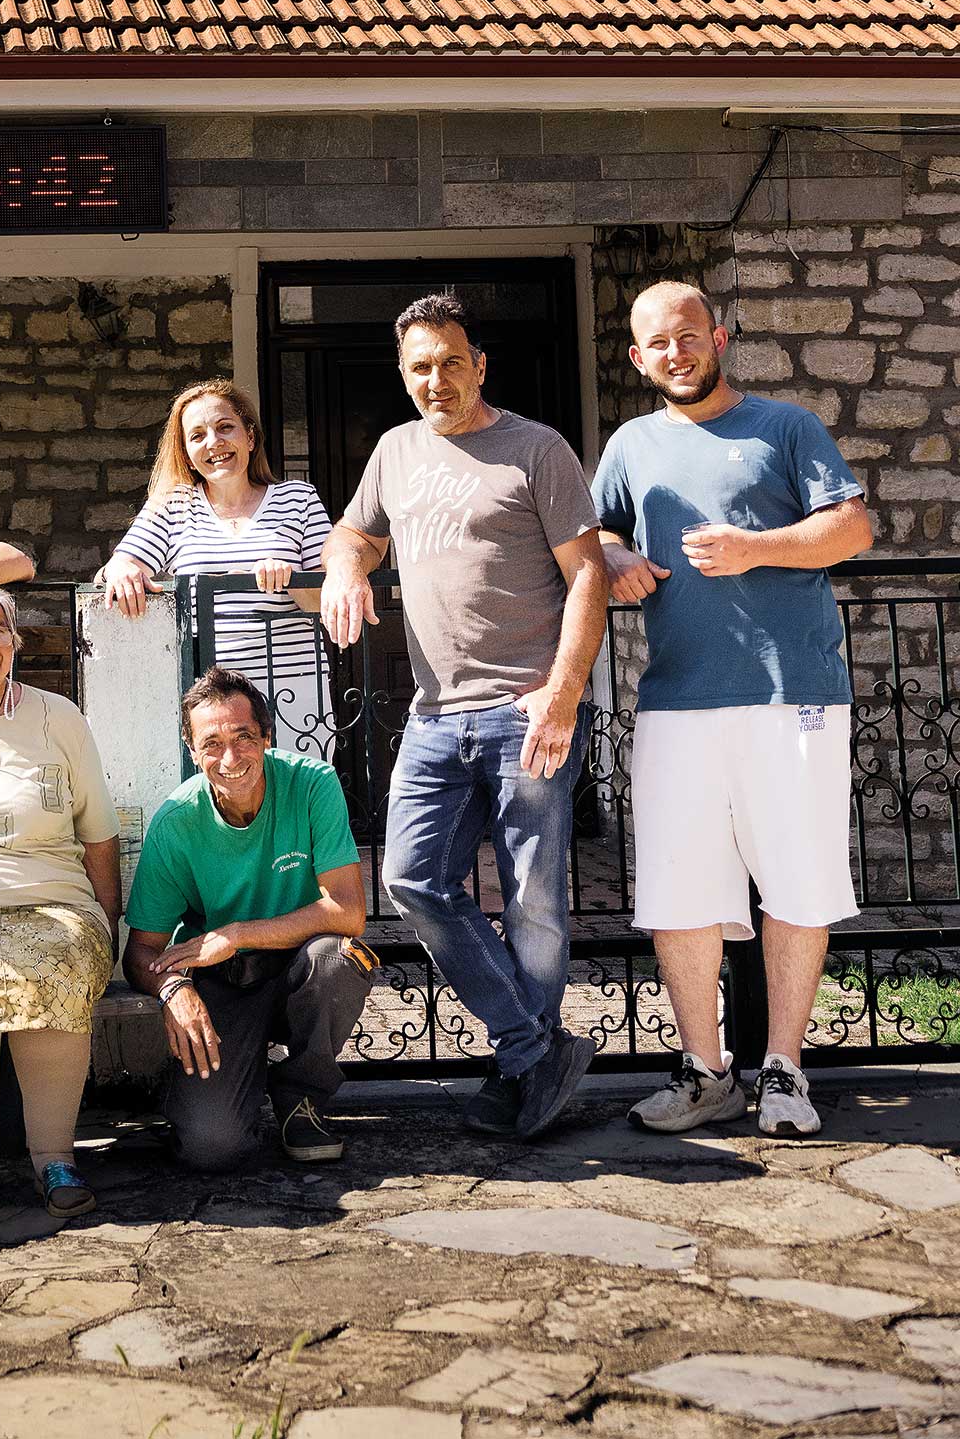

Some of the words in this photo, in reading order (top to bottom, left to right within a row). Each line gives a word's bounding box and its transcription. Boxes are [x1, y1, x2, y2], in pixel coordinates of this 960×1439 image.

[400, 461, 481, 509] Stay
[396, 497, 473, 563] Wild
[799, 722, 826, 732] YOURSELF
[800, 714, 824, 725] RELEASE
